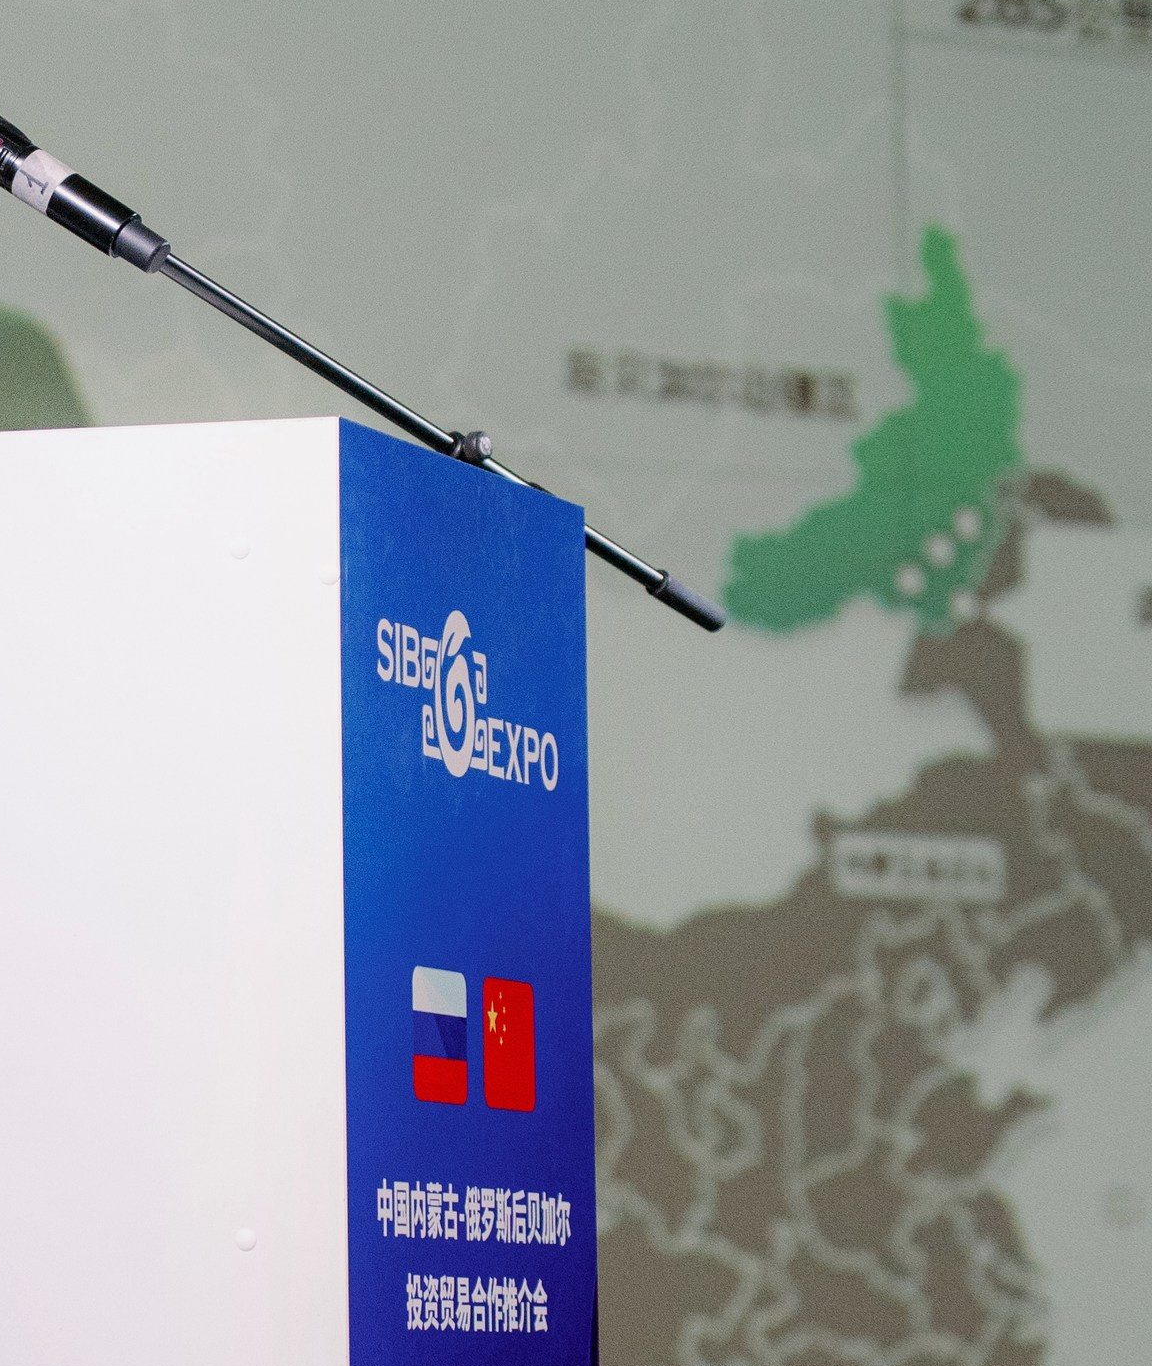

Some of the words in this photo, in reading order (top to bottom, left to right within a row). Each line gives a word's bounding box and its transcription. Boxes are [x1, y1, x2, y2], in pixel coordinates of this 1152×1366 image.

[377, 619, 421, 688] SIB
[488, 717, 559, 792] EXPO
[377, 1178, 572, 1247] 中国内蒙古-俄罗斯后贝加尔
[406, 1273, 548, 1333] 投资贸易合作推介会
